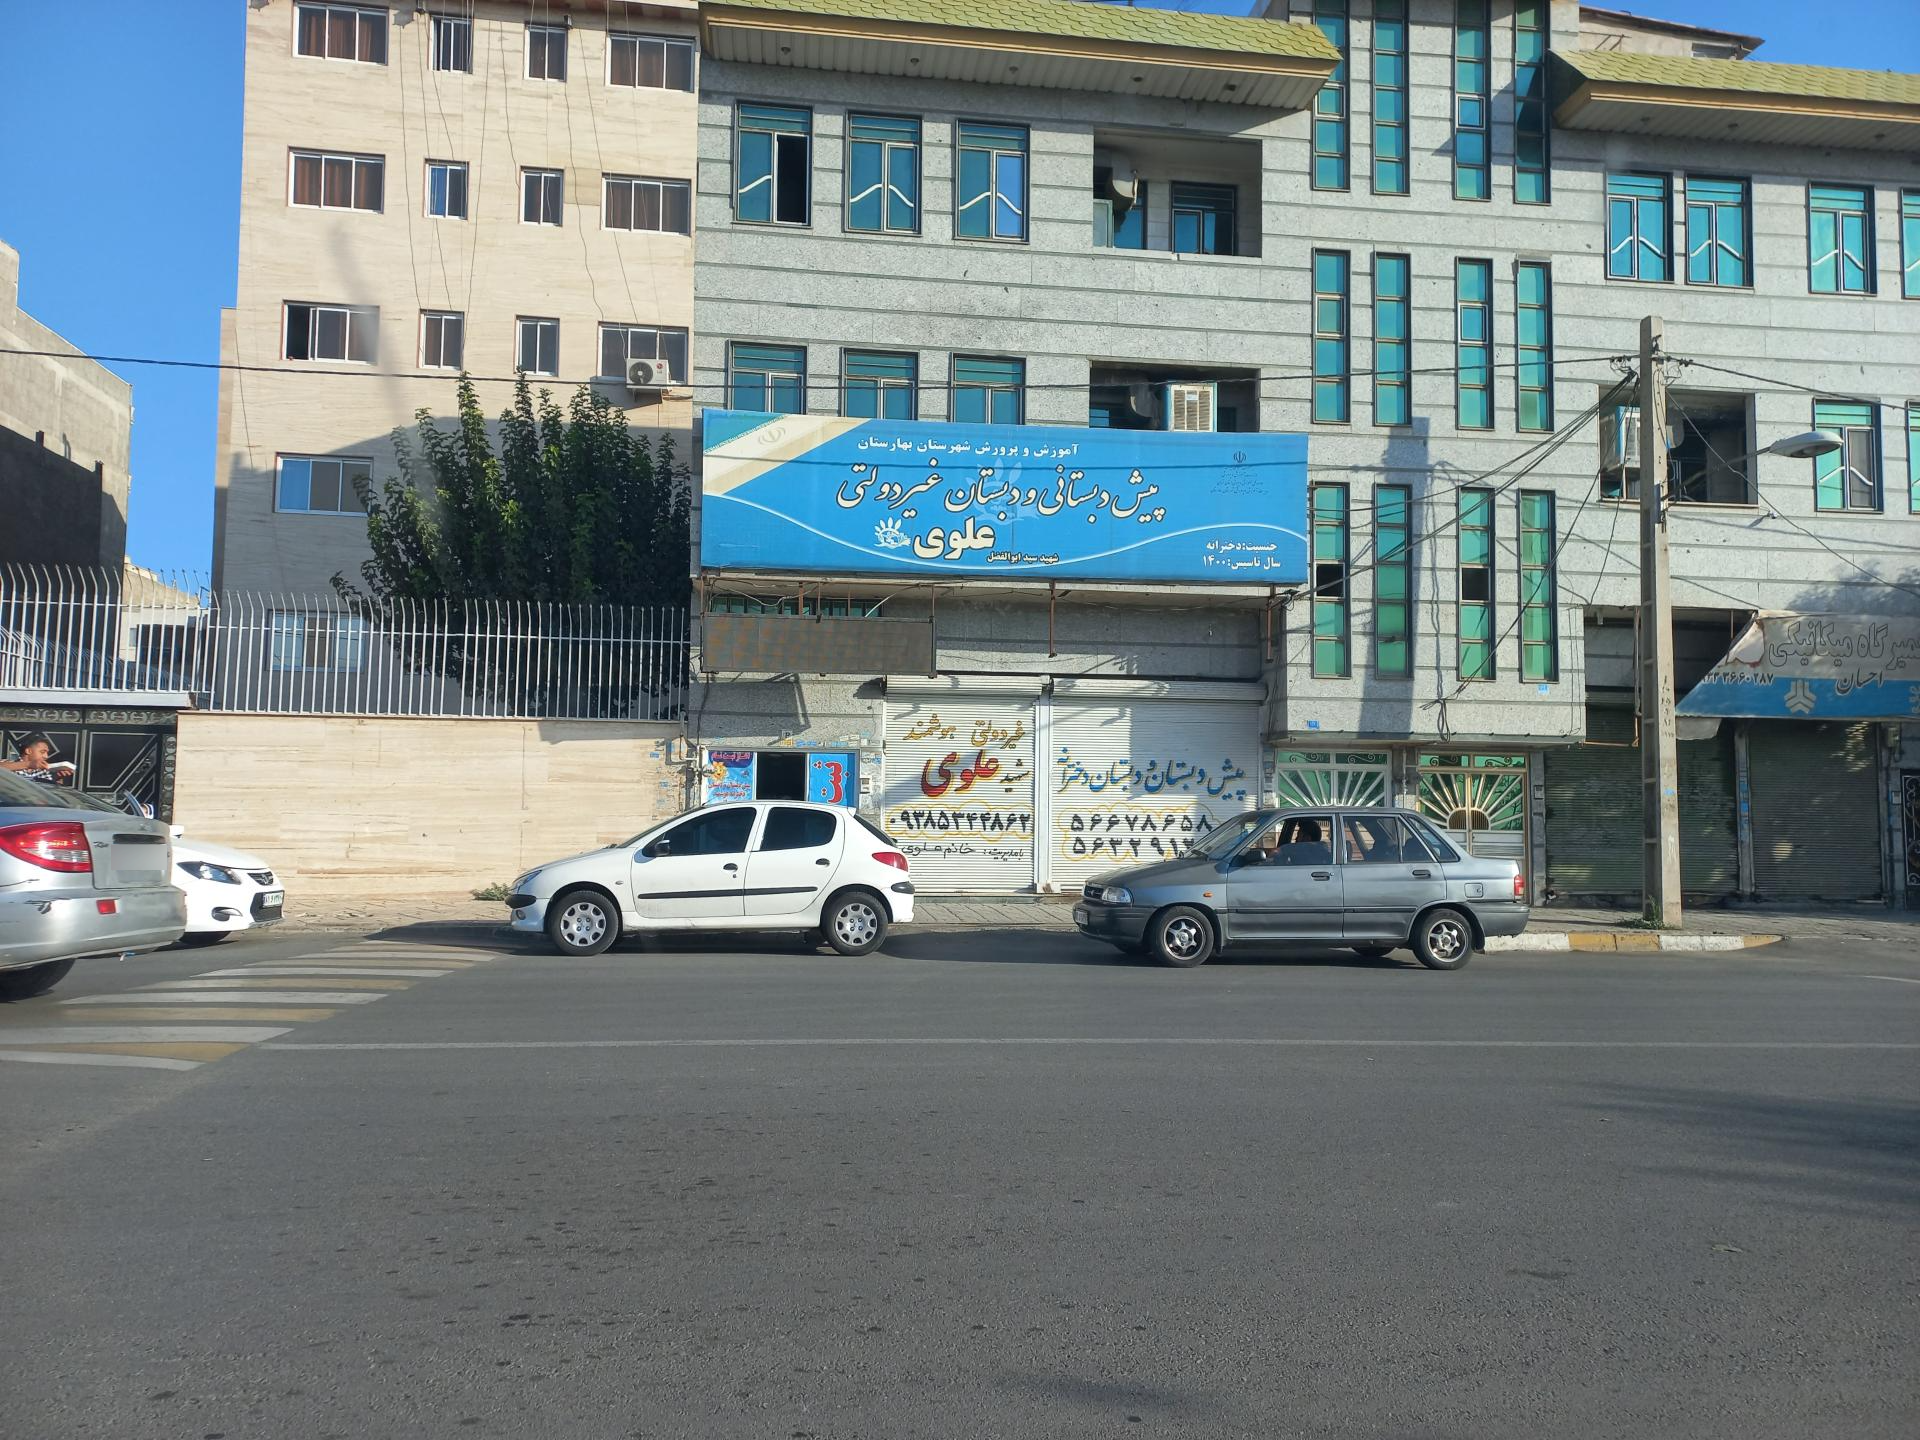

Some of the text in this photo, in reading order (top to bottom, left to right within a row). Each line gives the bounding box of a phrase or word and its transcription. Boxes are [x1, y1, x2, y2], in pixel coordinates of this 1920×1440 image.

[857, 436, 1079, 457] آموزش و پرورش شهرستان بهارستان
[943, 466, 1021, 521] دبستان
[1025, 484, 1037, 506] و
[1037, 464, 1110, 524] دبستانی
[1110, 469, 1166, 524] پیش
[913, 515, 996, 560] علوی
[987, 551, 1060, 564] شهید سید ابوالفضل
[1263, 556, 1281, 570] سال
[1835, 667, 1884, 694] احسان
[902, 712, 957, 741] هوشمند
[920, 749, 1001, 798] علوی
[1089, 759, 1143, 793] دبستان
[1144, 759, 1207, 793] دبستان
[1207, 758, 1247, 801] پیش
[889, 809, 1031, 832] ۰۹۳۸۵۳۴۴۸۶۲
[1071, 814, 1213, 832] ۵۶۶۷۸۶۵۸
